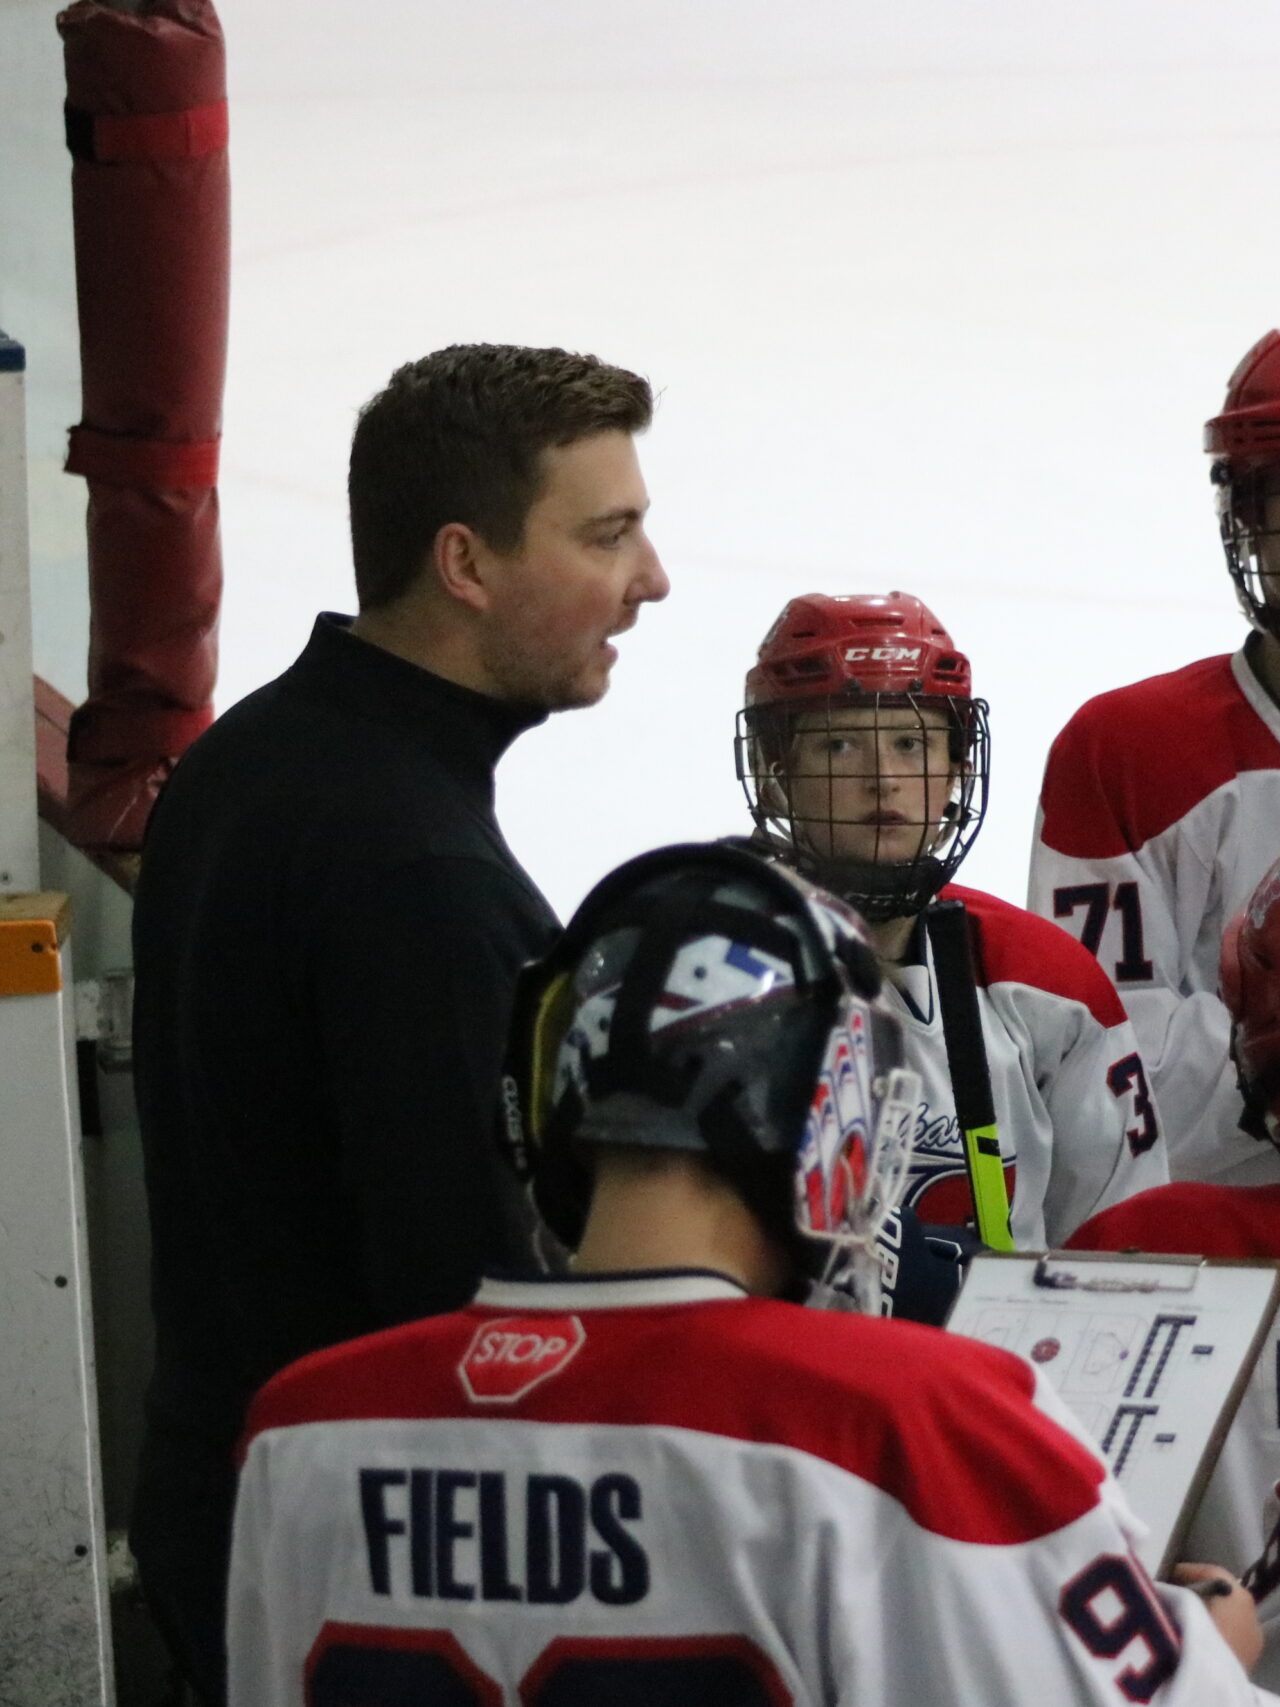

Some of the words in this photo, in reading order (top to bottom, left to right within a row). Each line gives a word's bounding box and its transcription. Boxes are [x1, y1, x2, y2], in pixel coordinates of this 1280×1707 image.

[844, 646, 921, 663] CCM
[1053, 881, 1154, 984] 71
[473, 1330, 567, 1364] STOP
[358, 1467, 652, 1606] FIELDS
